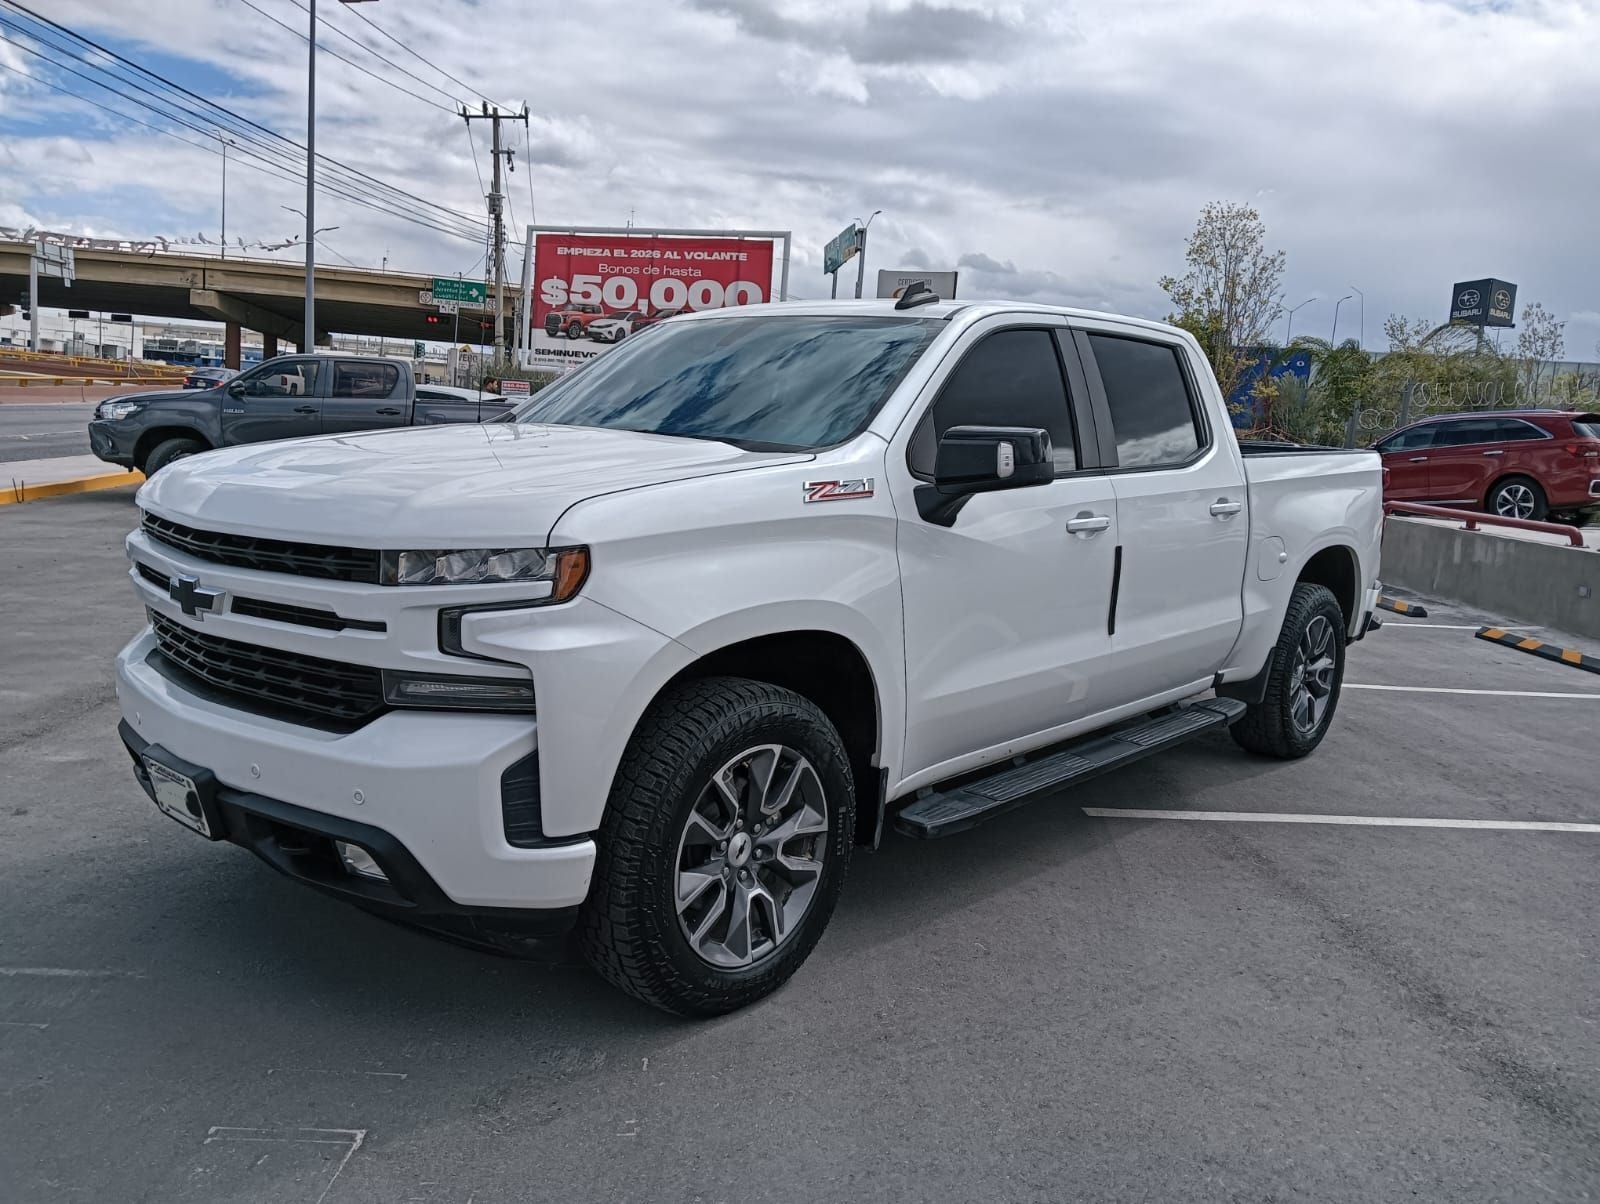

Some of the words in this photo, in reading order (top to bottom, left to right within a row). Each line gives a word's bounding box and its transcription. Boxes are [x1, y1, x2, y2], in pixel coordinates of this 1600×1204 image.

[557, 247, 611, 257] EMPIEZA
[614, 249, 628, 257] EL
[630, 249, 661, 259] 2026
[663, 250, 681, 259] AL
[684, 251, 748, 261] VOLANTE
[598, 263, 640, 274] Bonos
[642, 264, 660, 275] de
[663, 265, 702, 277] hasta
[540, 274, 763, 315] $50,000
[1453, 308, 1482, 318] SUBARU
[1489, 308, 1512, 319] SUBARU
[803, 478, 875, 503] Z71
